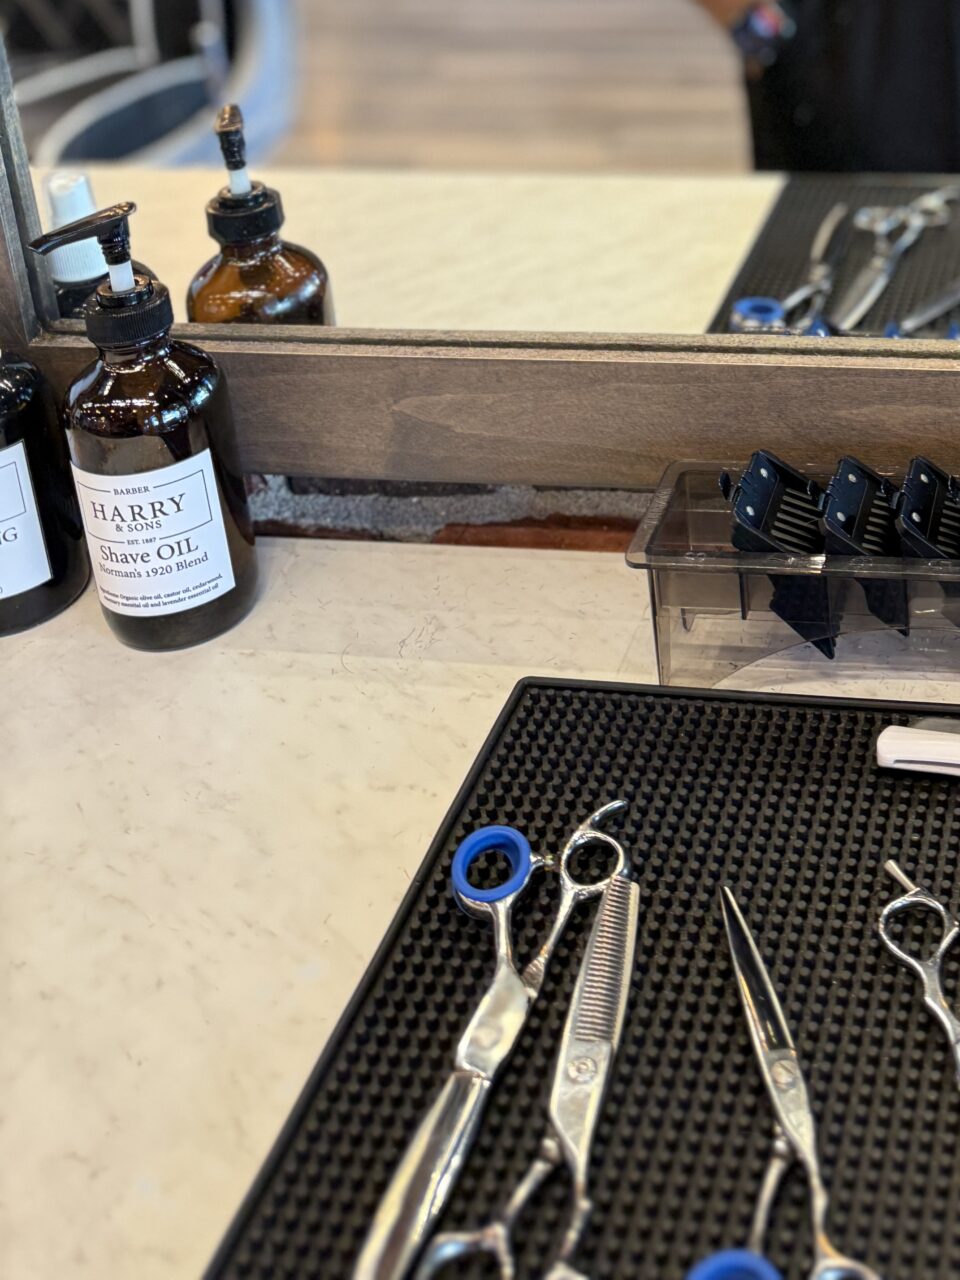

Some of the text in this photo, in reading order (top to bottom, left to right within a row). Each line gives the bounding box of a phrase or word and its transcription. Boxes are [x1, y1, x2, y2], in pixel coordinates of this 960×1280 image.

[113, 486, 151, 496] BARBER
[90, 492, 186, 523] HARRY
[115, 520, 162, 533] & SONS
[100, 536, 199, 564] Shave OIL
[99, 551, 209, 579] Norman's 1920 Blend
